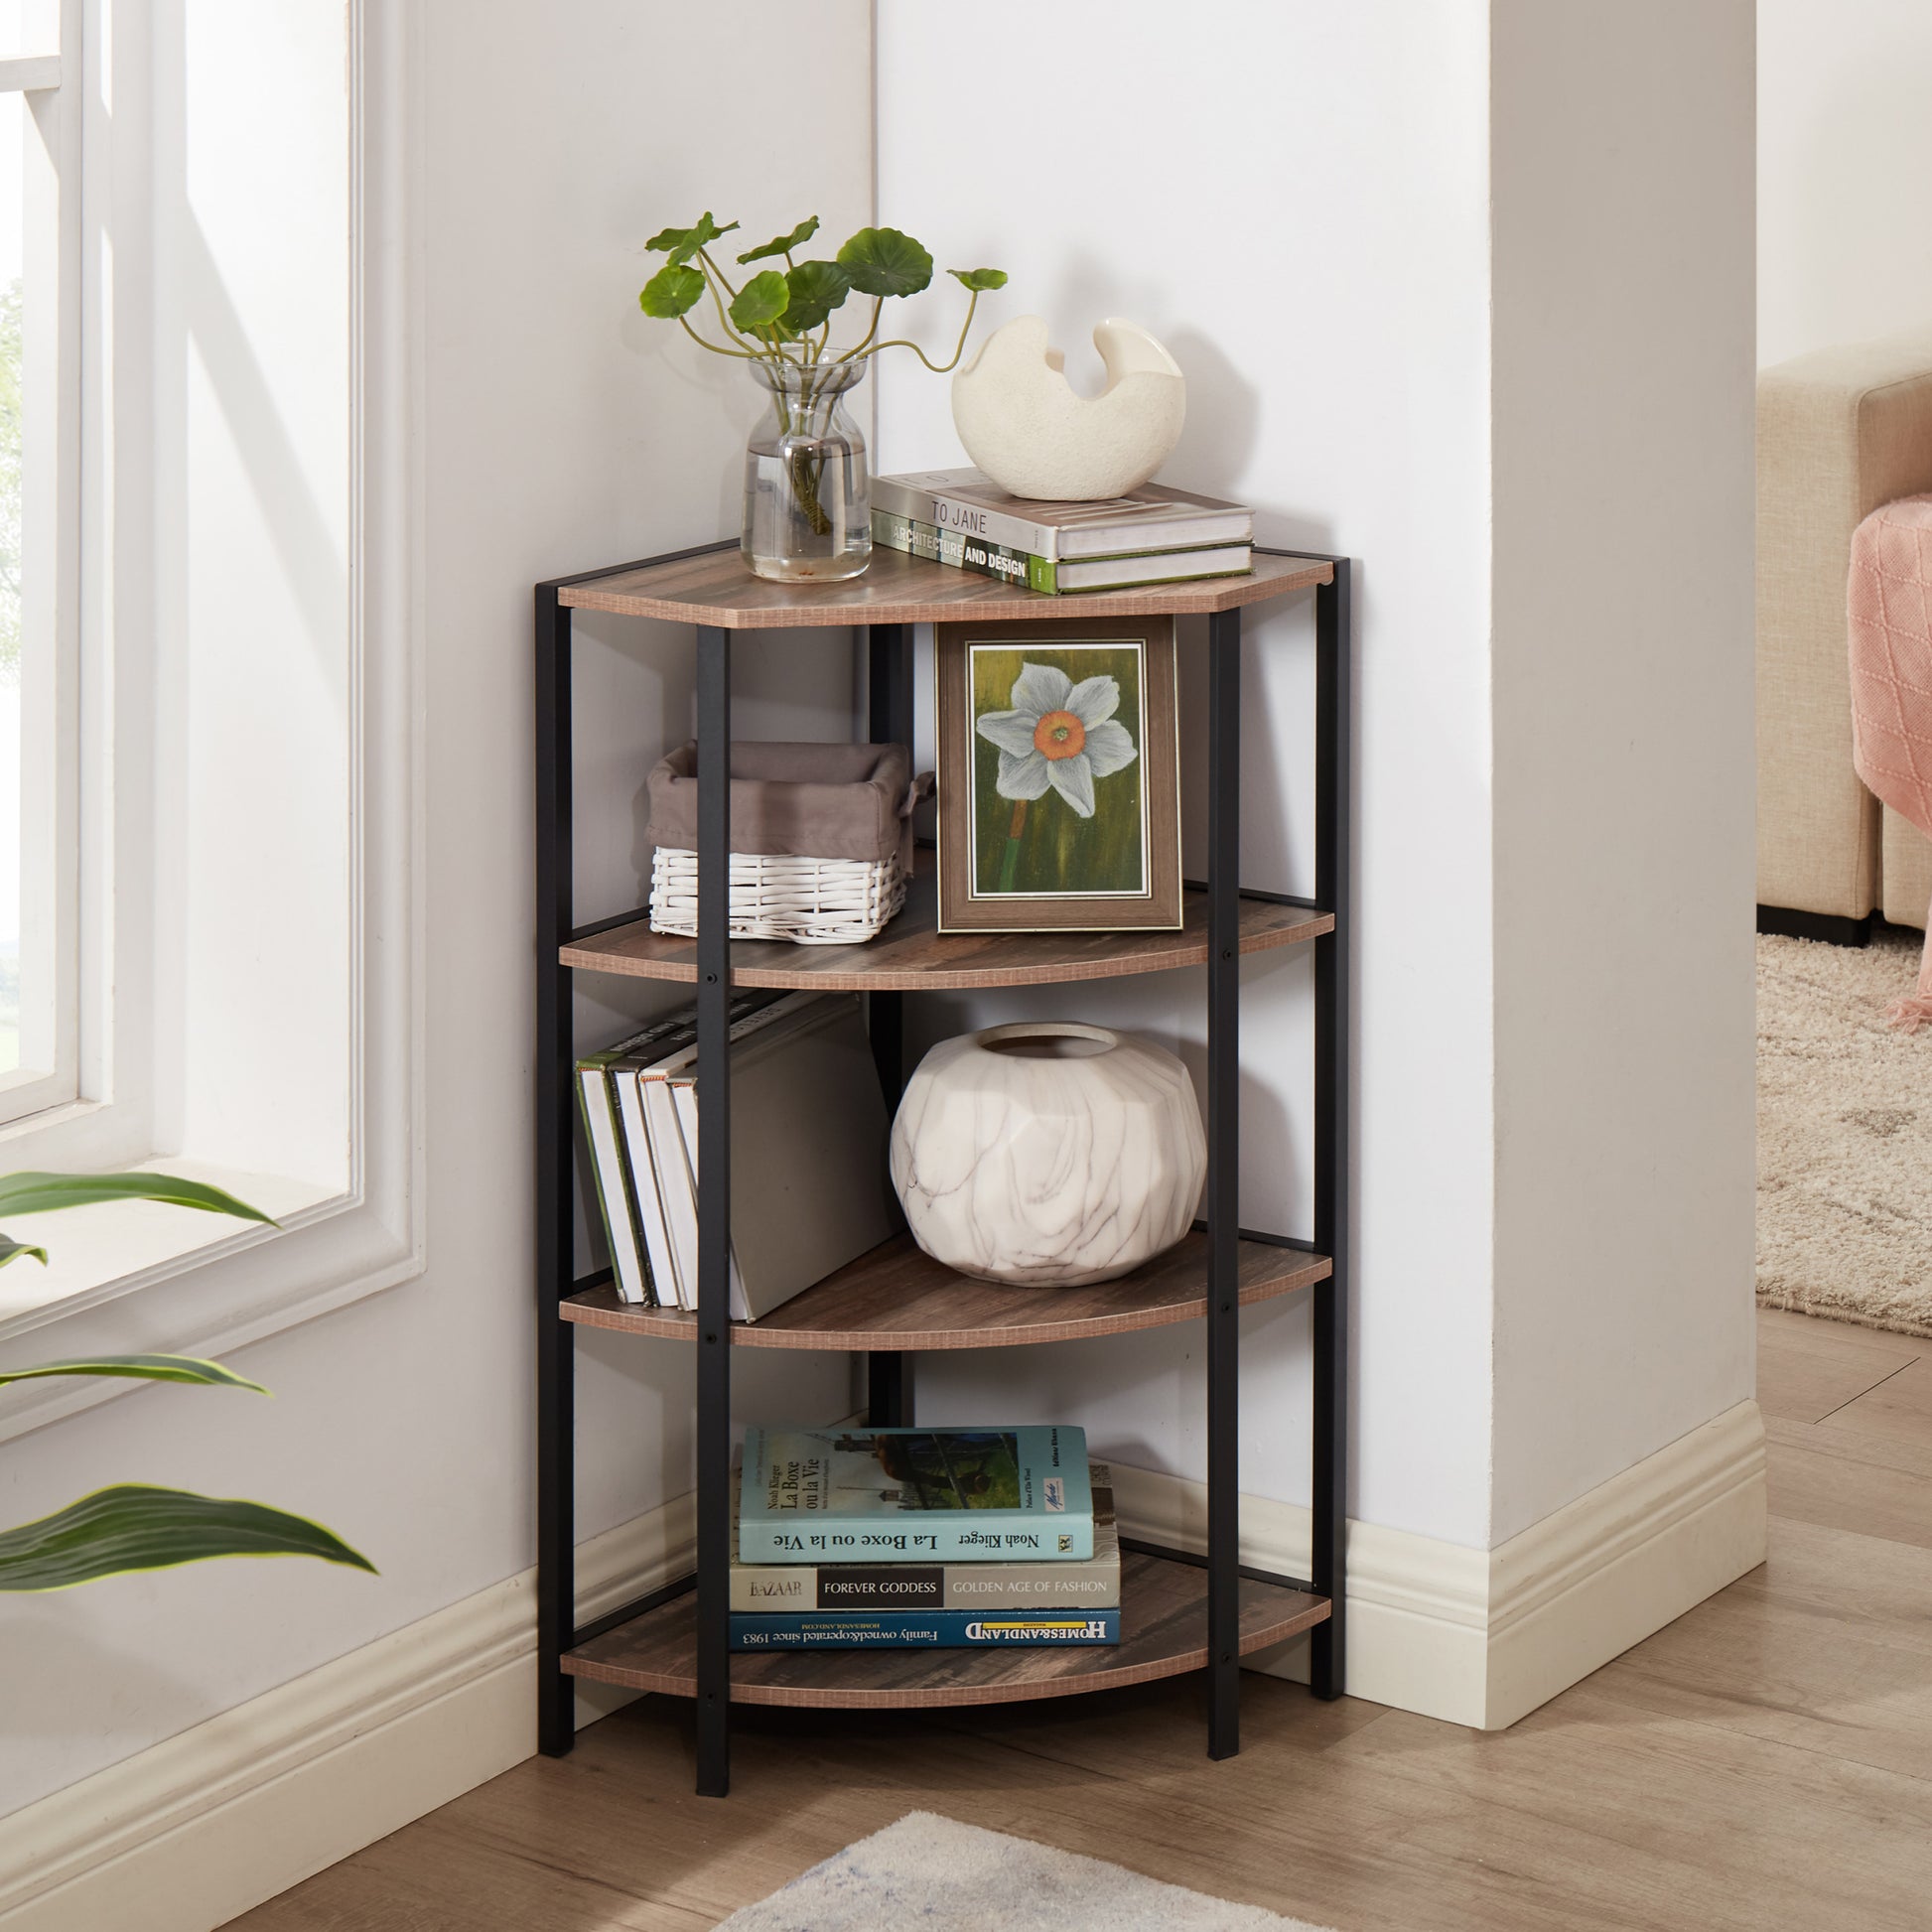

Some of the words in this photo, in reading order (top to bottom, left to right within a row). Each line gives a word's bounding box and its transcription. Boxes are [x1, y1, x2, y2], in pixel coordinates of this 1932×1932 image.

[930, 500, 948, 522] TO
[952, 507, 987, 534] JANE
[893, 525, 964, 559] ARCHITECTURE
[965, 547, 987, 566] AND
[988, 554, 1027, 578] DESIGN
[780, 1461, 800, 1490] Boxe
[802, 1458, 820, 1478] Vie
[768, 1464, 782, 1488] Klieger
[802, 1481, 819, 1492] la
[767, 1490, 778, 1510] Noah
[780, 1494, 798, 1510] La
[805, 1495, 819, 1510] ou
[772, 1535, 804, 1550] Vie
[810, 1534, 827, 1550] la
[831, 1535, 856, 1548] ou
[861, 1534, 906, 1550] Boxe
[913, 1535, 938, 1550] La
[958, 1530, 1002, 1548] Klieger
[1005, 1534, 1040, 1549] Noah
[749, 1581, 803, 1596] BAZAAR
[824, 1582, 877, 1593] FOREVER
[879, 1581, 937, 1593] GODDESS
[953, 1581, 1003, 1593] GOLDEN
[1007, 1581, 1033, 1593] AGE
[1035, 1581, 1052, 1593] OF
[1054, 1581, 1107, 1593] FASHION
[802, 1629, 897, 1643] owned&operated
[898, 1628, 938, 1642] Family
[965, 1619, 1106, 1640] HOMES&ANDLAND
[743, 1632, 770, 1644] 1983
[772, 1632, 801, 1644] since
